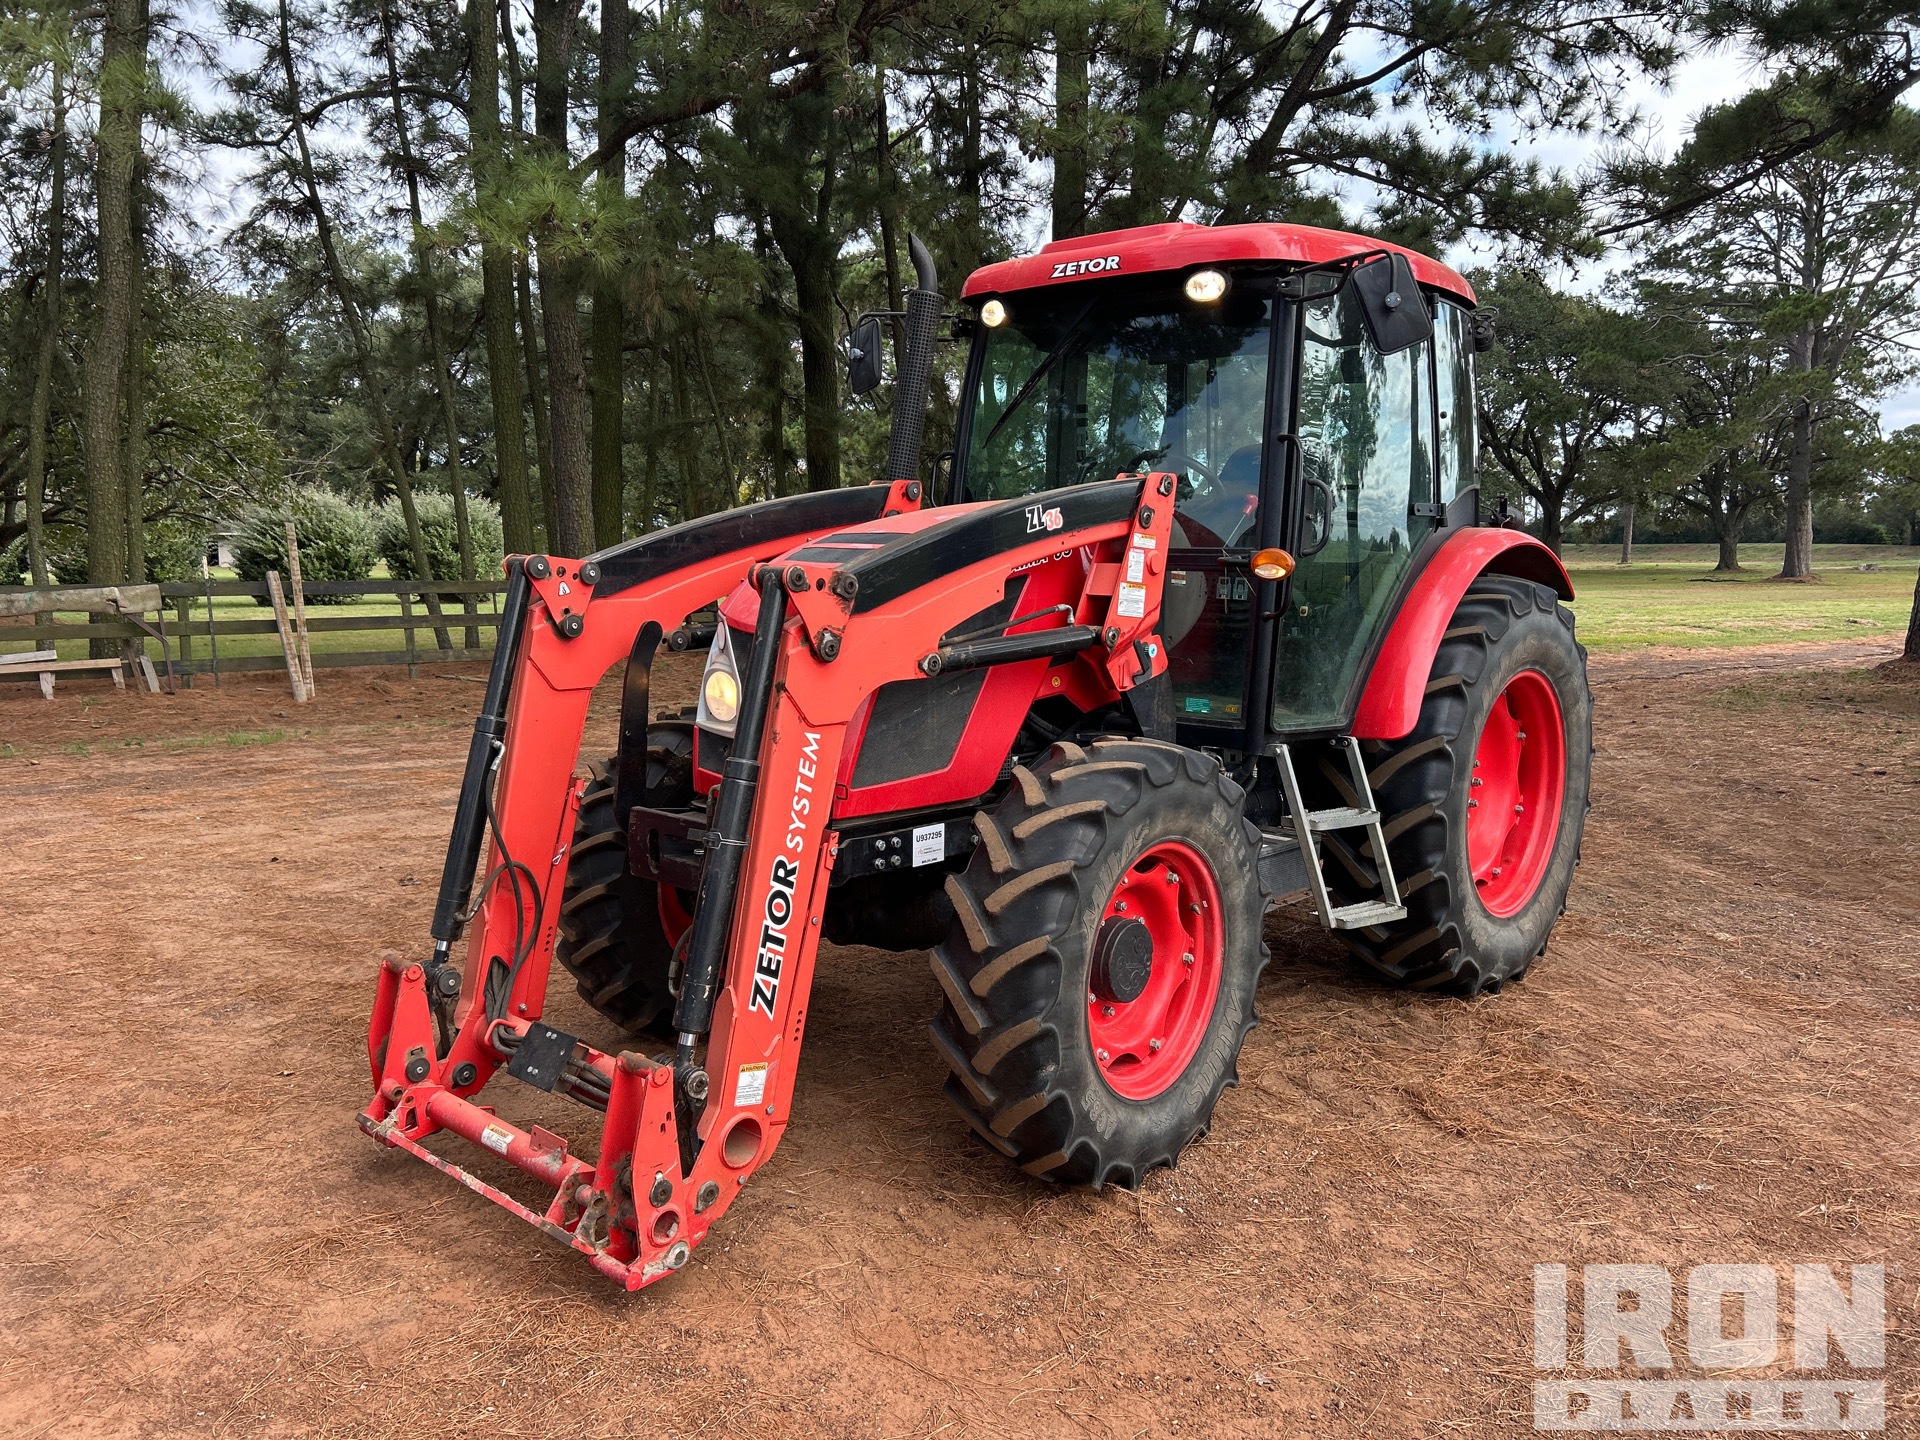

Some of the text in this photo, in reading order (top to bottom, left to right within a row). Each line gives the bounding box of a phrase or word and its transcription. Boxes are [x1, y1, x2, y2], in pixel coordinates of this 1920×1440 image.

[1049, 255, 1121, 279] ZETOR
[916, 830, 942, 843] U937295
[748, 731, 821, 1021] ZETOR SYSTEM
[1182, 987, 1243, 1114] MITAS
[1081, 1089, 1118, 1140] AC85
